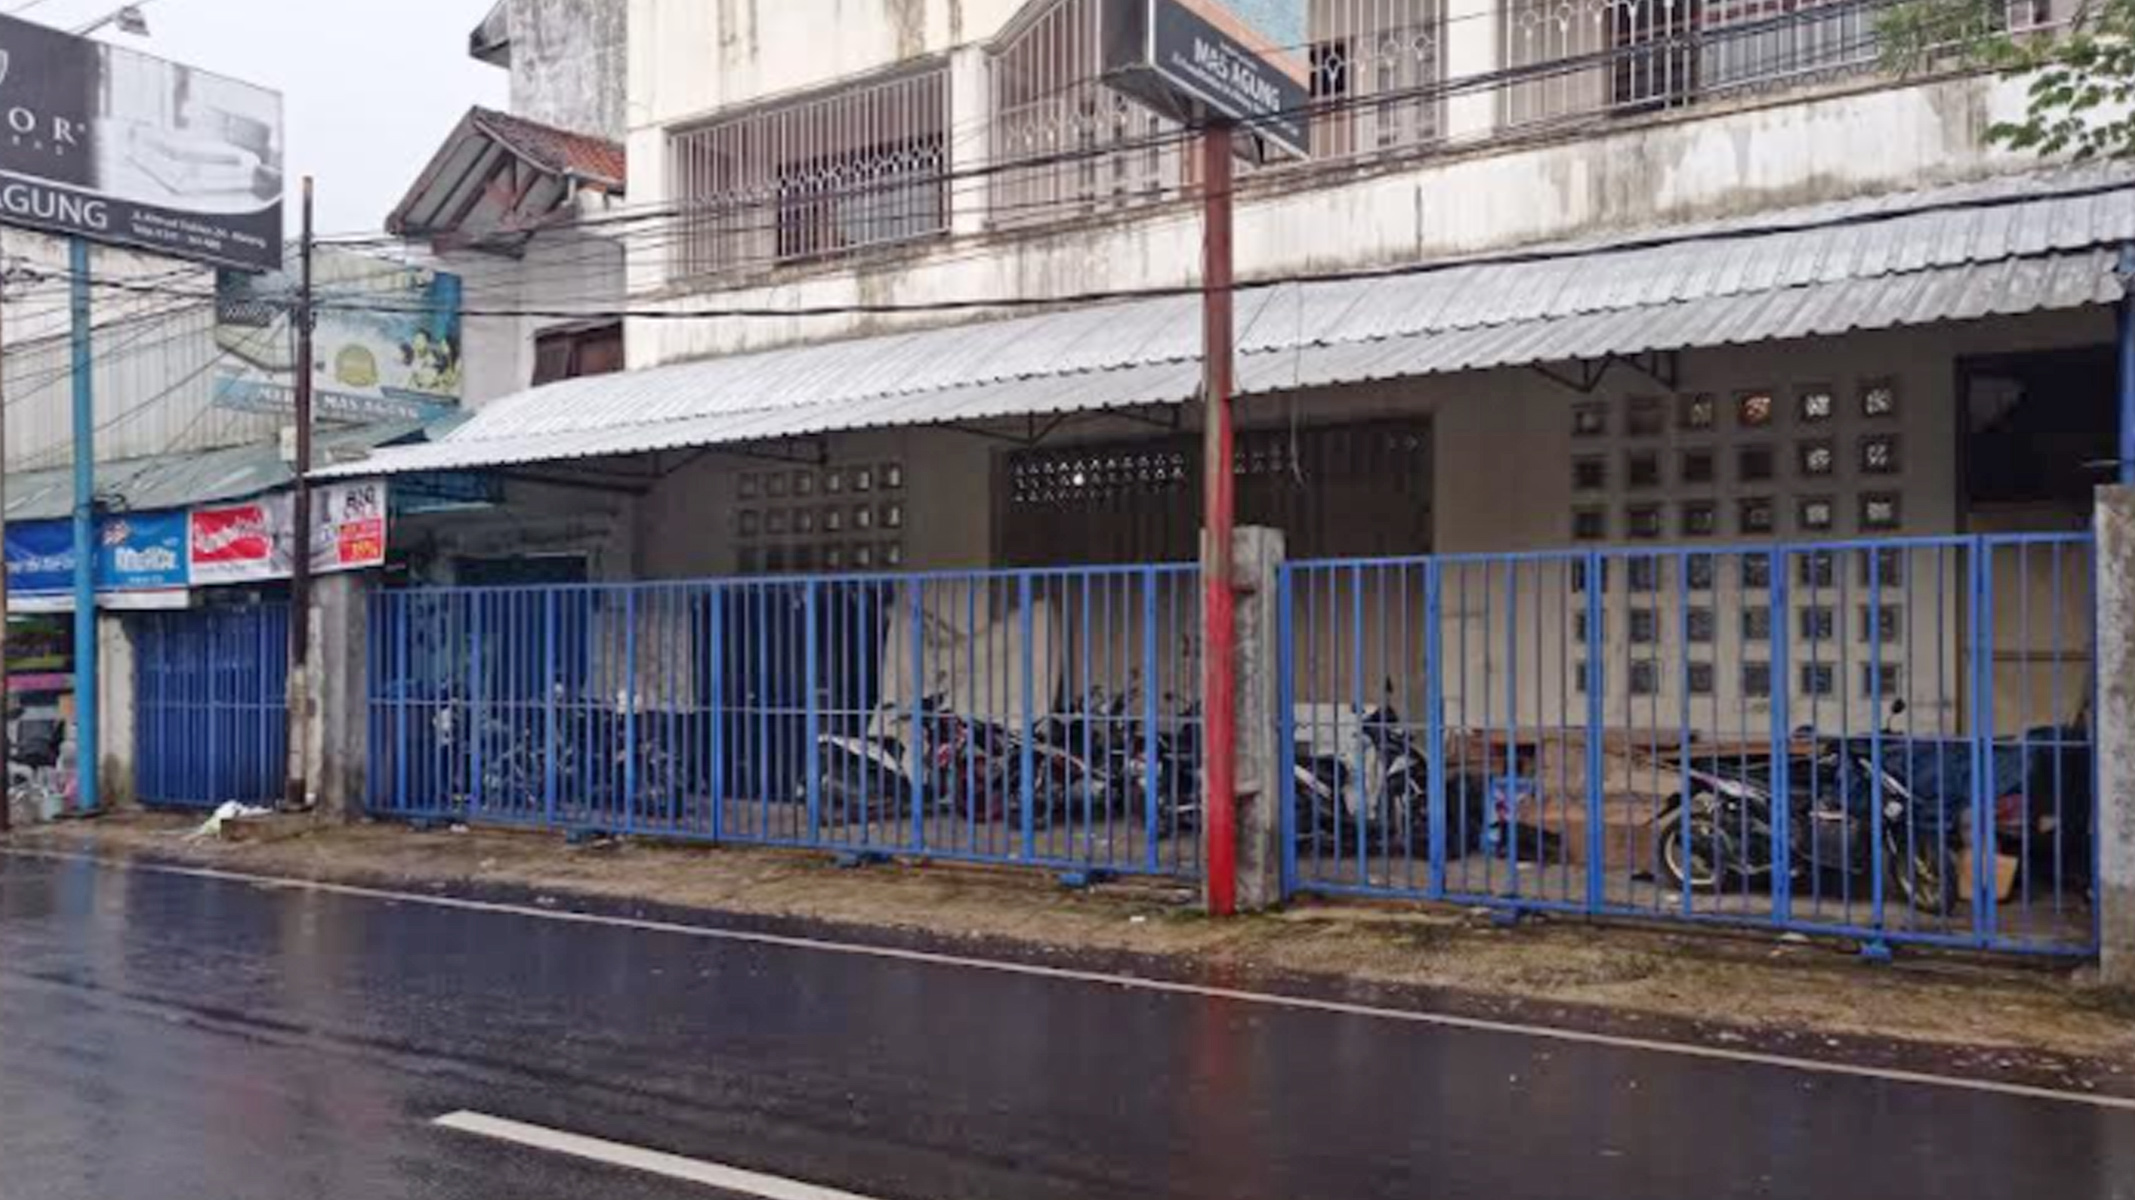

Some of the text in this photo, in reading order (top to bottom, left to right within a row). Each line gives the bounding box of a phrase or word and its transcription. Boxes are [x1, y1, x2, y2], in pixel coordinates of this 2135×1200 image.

[1194, 37, 1229, 79] MAS
[1231, 61, 1281, 112] AGUNG
[0, 183, 108, 229] GUNG
